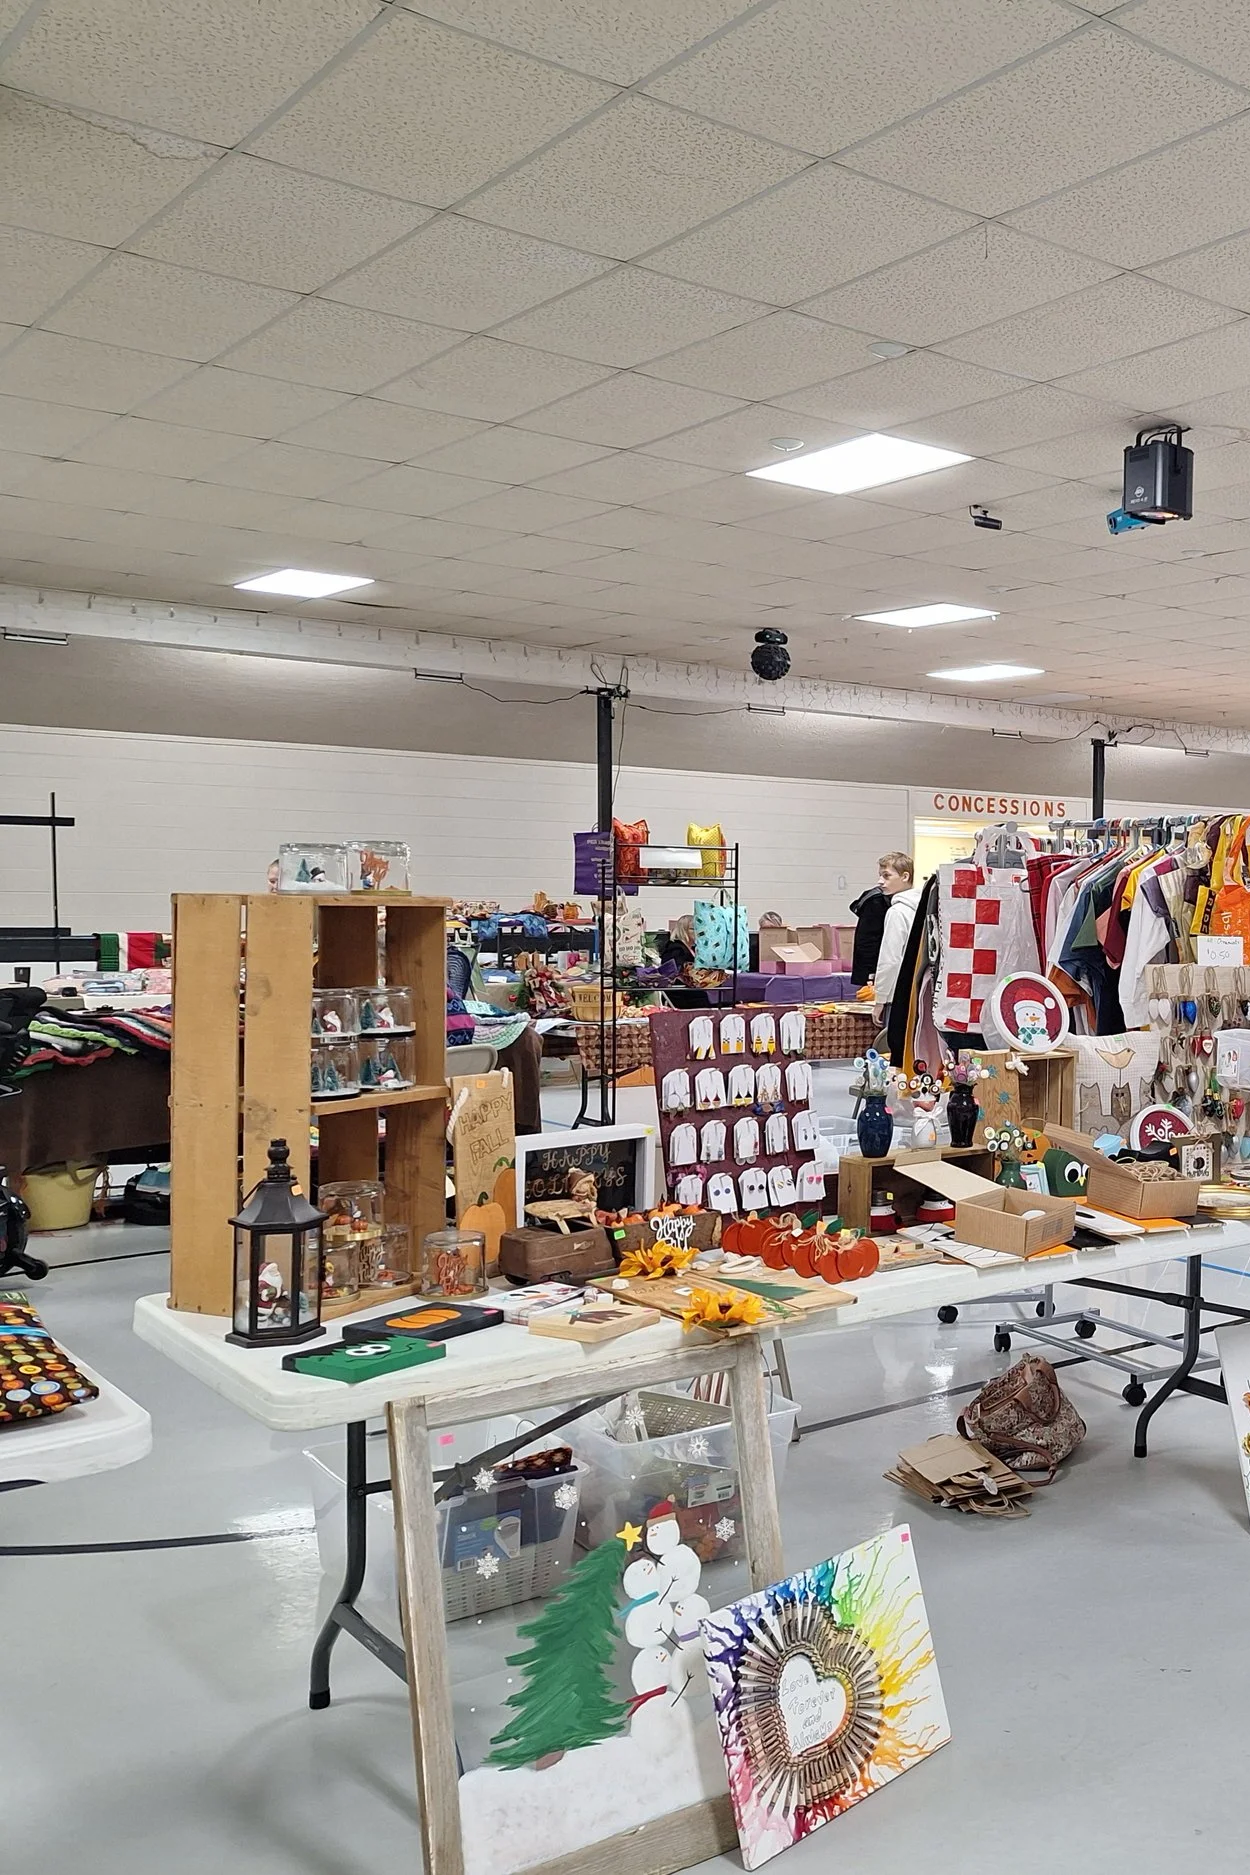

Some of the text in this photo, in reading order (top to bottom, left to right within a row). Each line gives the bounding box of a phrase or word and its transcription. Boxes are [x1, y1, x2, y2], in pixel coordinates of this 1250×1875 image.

[933, 793, 1066, 818] CONCESSIONS
[578, 993, 612, 1003] WELCM
[458, 1092, 512, 1136] HAPPY
[469, 1128, 509, 1165] FALL
[542, 1142, 611, 1171] HAPPY
[650, 1215, 696, 1241] Happy
[781, 1674, 809, 1697] Love
[788, 1687, 836, 1715] Forever
[802, 1706, 822, 1730] and
